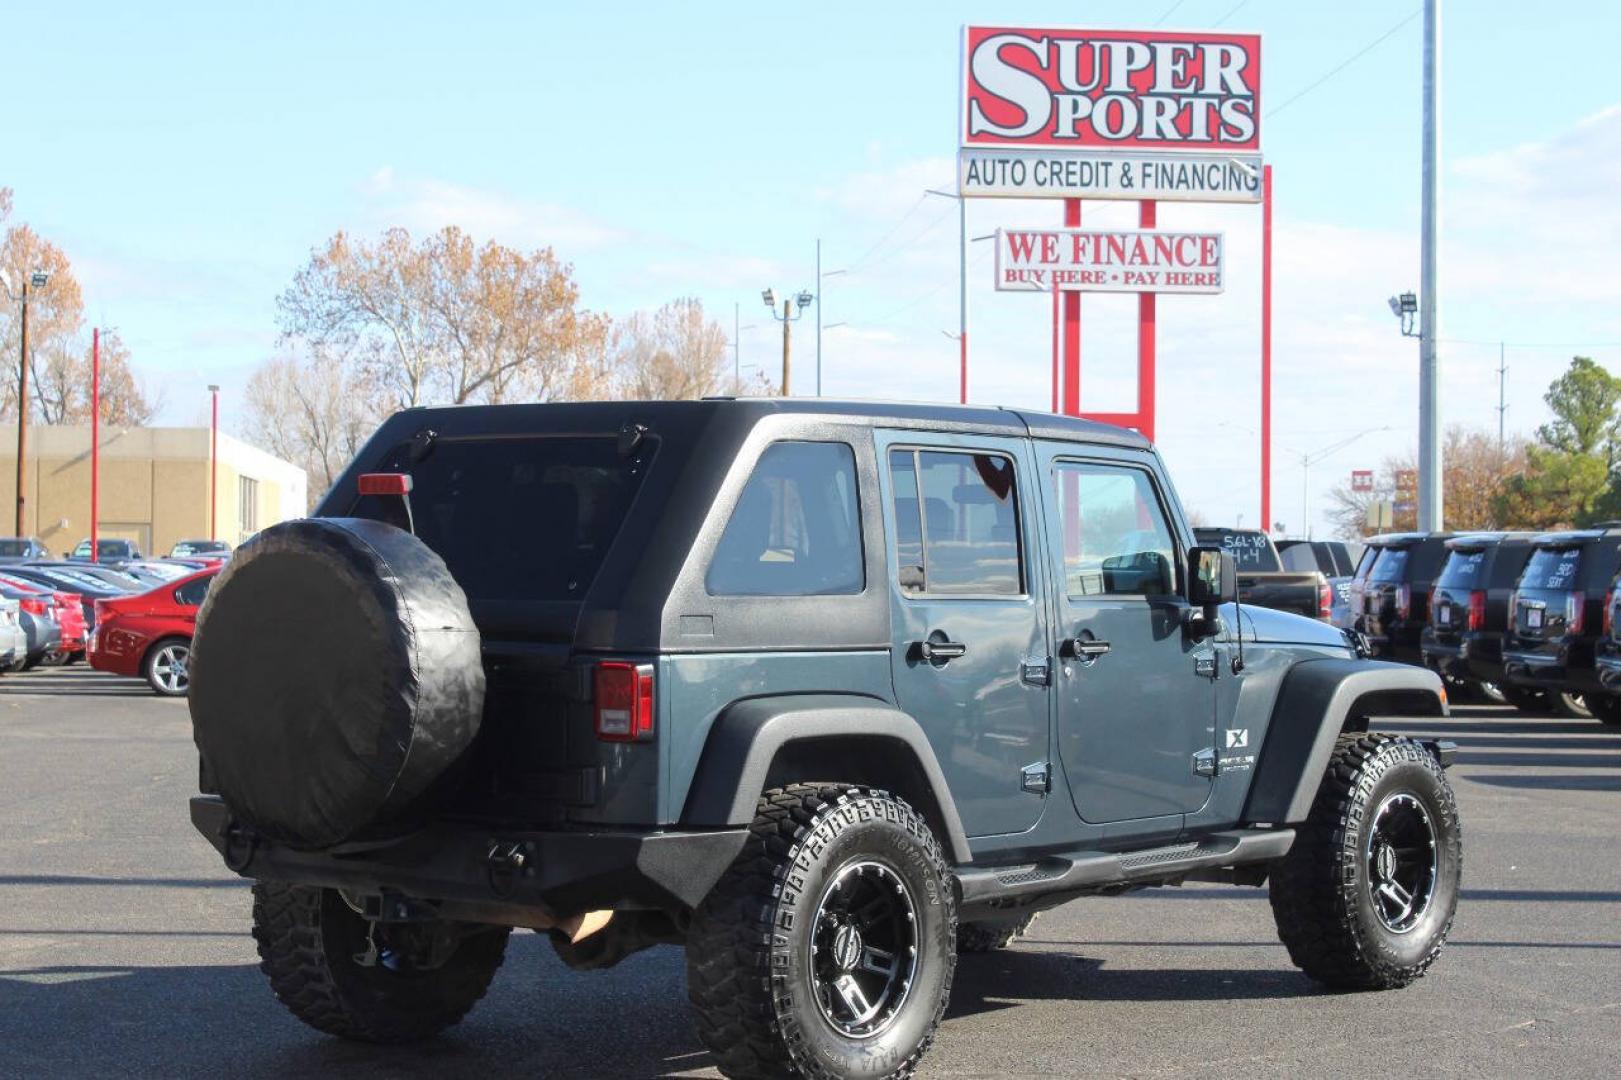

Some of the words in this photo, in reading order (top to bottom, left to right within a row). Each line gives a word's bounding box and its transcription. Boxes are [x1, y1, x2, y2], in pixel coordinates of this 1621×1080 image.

[969, 33, 1254, 139] SUPER
[966, 158, 1027, 187] AUTO
[1034, 160, 1113, 188] CREDIT
[1120, 161, 1134, 189] &
[1141, 162, 1260, 191] FINANCING
[1006, 232, 1060, 264] WE
[1070, 234, 1220, 267] FINANCE
[1005, 269, 1046, 283] BUY
[1051, 270, 1107, 285] HERE
[1123, 271, 1160, 285] PAY
[1165, 272, 1221, 287] HERE
